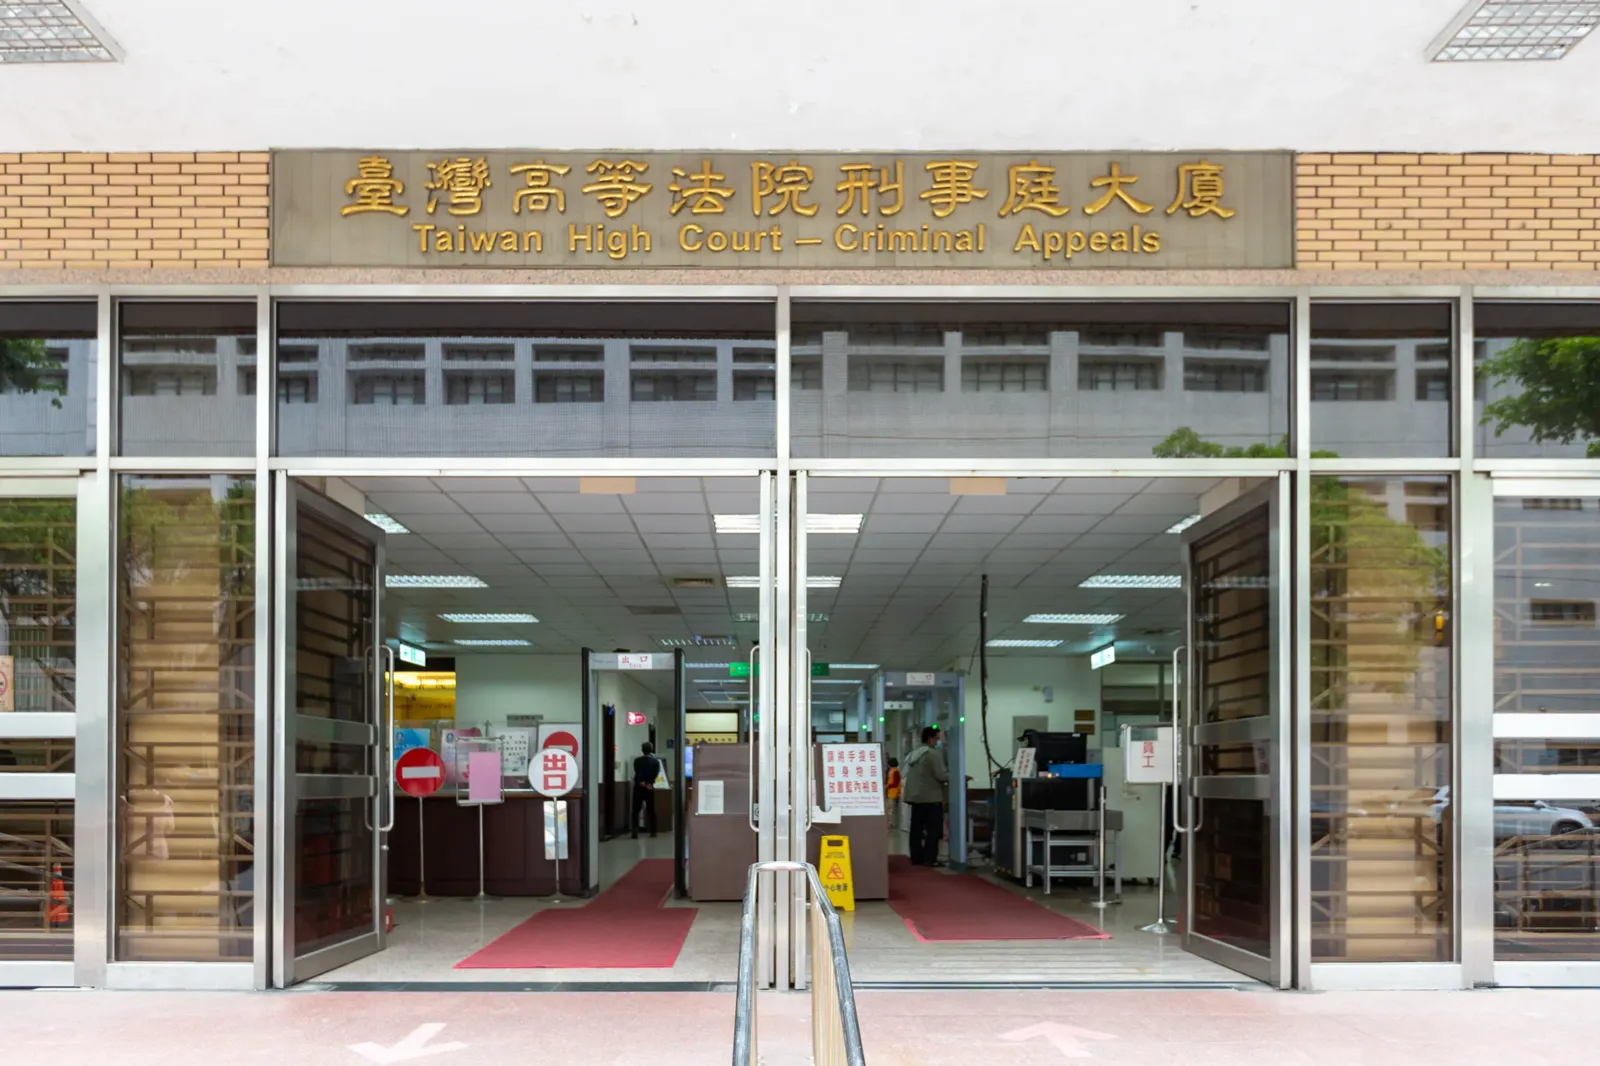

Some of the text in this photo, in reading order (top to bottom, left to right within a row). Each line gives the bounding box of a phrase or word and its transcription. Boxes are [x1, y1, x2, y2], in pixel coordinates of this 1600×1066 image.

[341, 156, 1236, 219] 臺灣高等法院刑事庭大廈
[413, 224, 543, 253] Taiwan
[568, 224, 652, 260] High
[679, 224, 783, 253] Court
[834, 224, 985, 253] Criminal
[1014, 224, 1161, 261] Appeals
[543, 753, 567, 791] 出口
